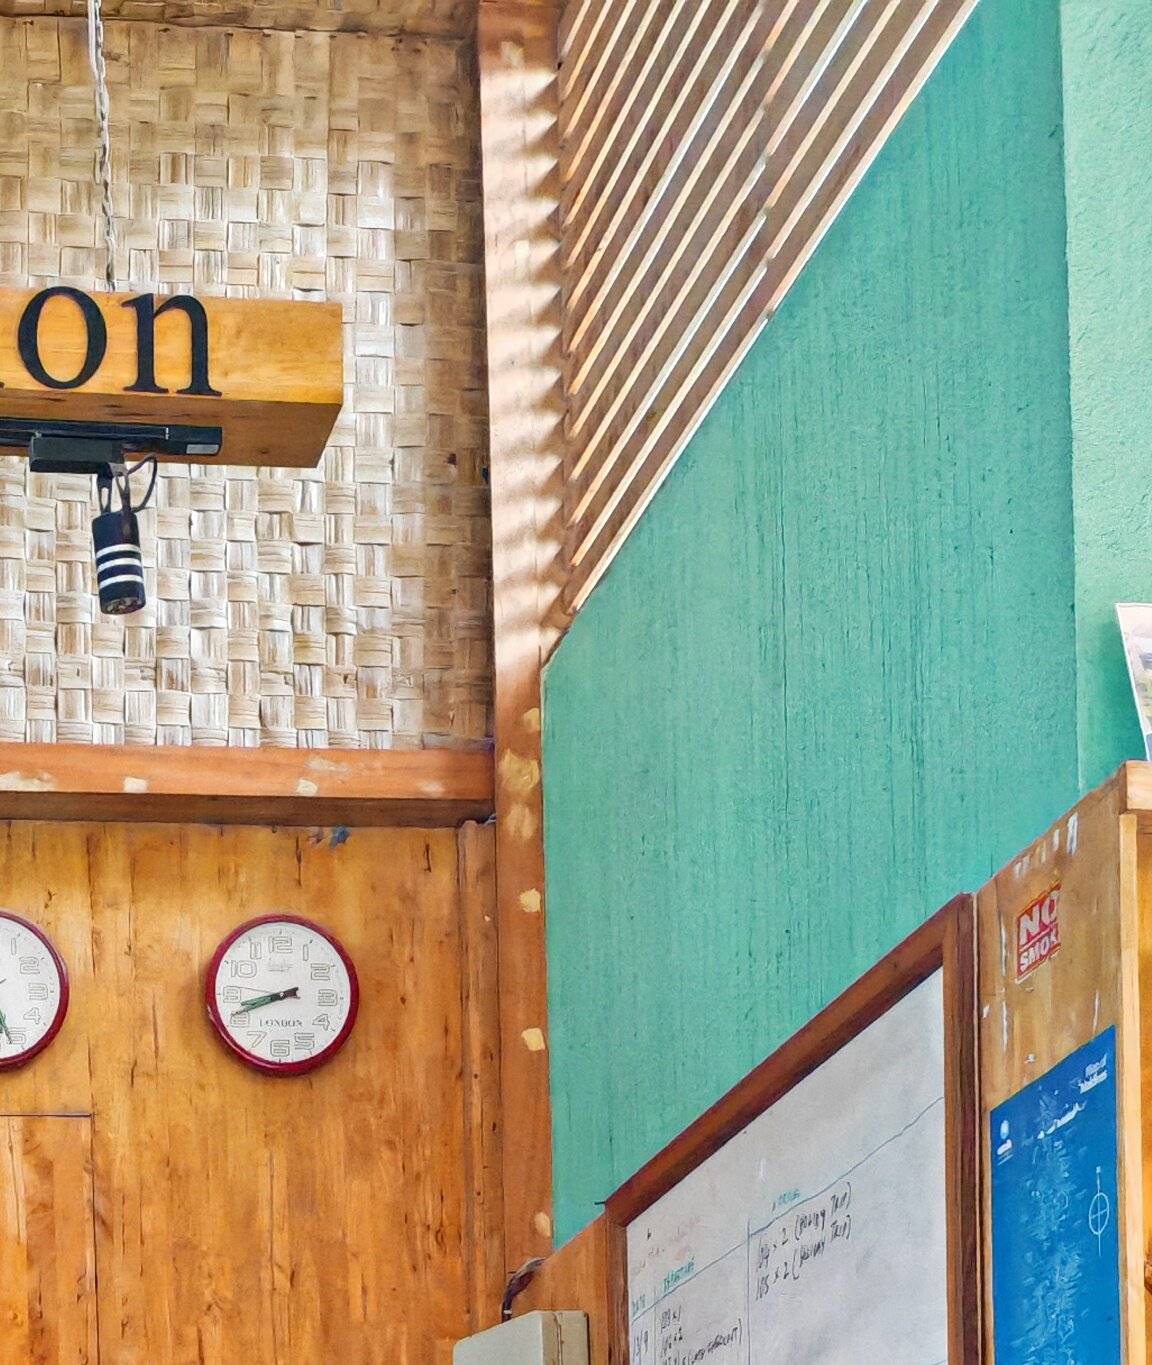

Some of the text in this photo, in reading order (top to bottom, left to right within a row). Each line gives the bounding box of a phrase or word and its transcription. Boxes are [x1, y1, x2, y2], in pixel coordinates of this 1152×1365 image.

[1019, 889, 1060, 948] NO
[11, 938, 16, 955] 1
[250, 942, 261, 959] 11
[269, 936, 292, 953] 12
[303, 944, 309, 961] 1
[20, 957, 39, 974] 2
[231, 960, 257, 978] 10
[311, 963, 330, 980] 2
[29, 983, 48, 1000] 3
[223, 986, 241, 1003] 9
[318, 989, 338, 1006] 3
[24, 1007, 41, 1024] 4
[231, 1012, 250, 1028] 8
[313, 1014, 330, 1030] 4
[8, 1027, 26, 1044] 5
[247, 1031, 266, 1048] 7
[295, 1033, 314, 1050] 5
[270, 1040, 290, 1057] 6
